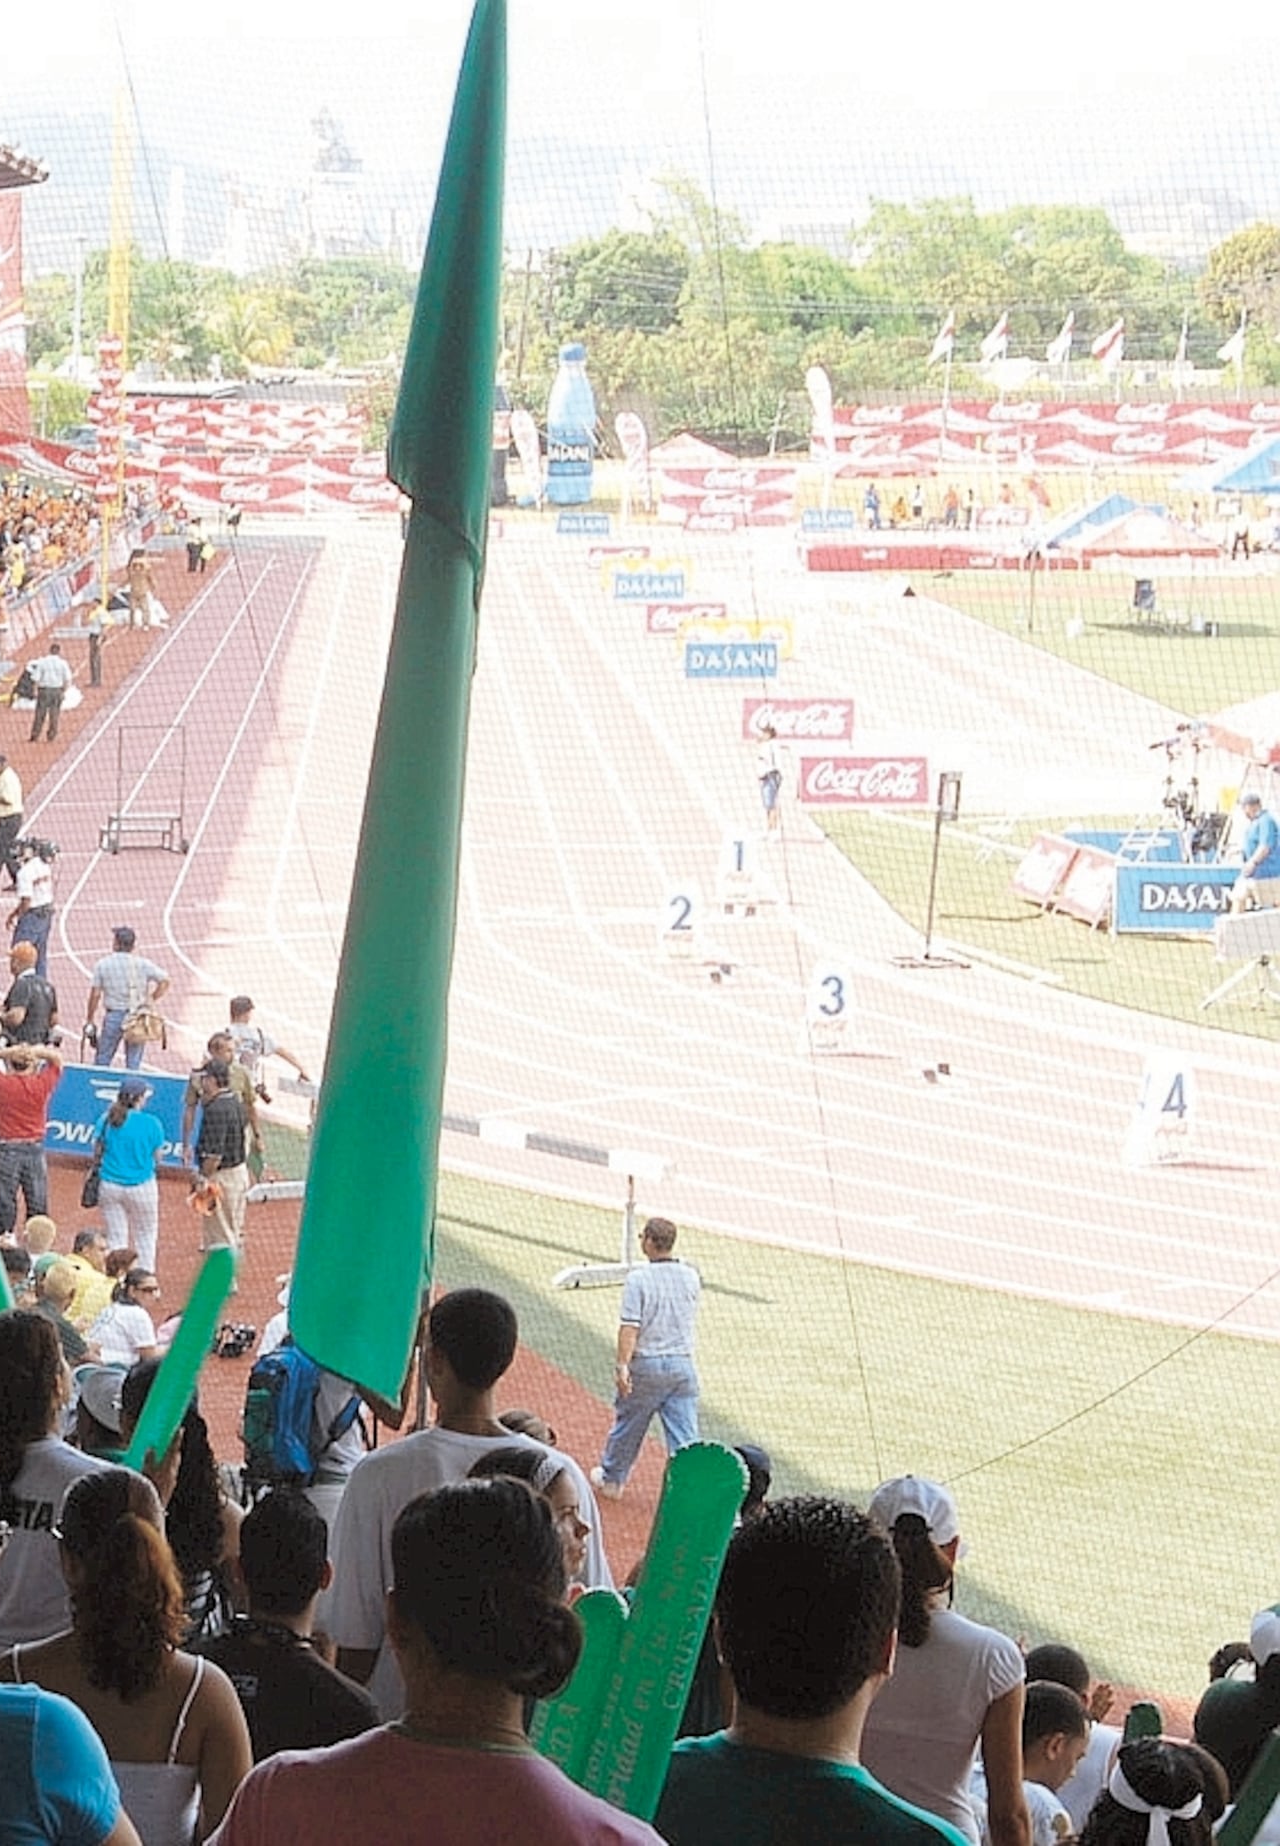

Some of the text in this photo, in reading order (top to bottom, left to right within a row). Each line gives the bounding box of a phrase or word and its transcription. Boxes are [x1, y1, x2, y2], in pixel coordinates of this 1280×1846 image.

[691, 646, 776, 672] DASANI
[806, 760, 921, 798] Coca-Cola
[732, 841, 744, 871] 1
[670, 895, 693, 931] 2
[819, 975, 845, 1017] 3
[1161, 1072, 1188, 1119] 4
[663, 1555, 720, 1710] CRUSADA
